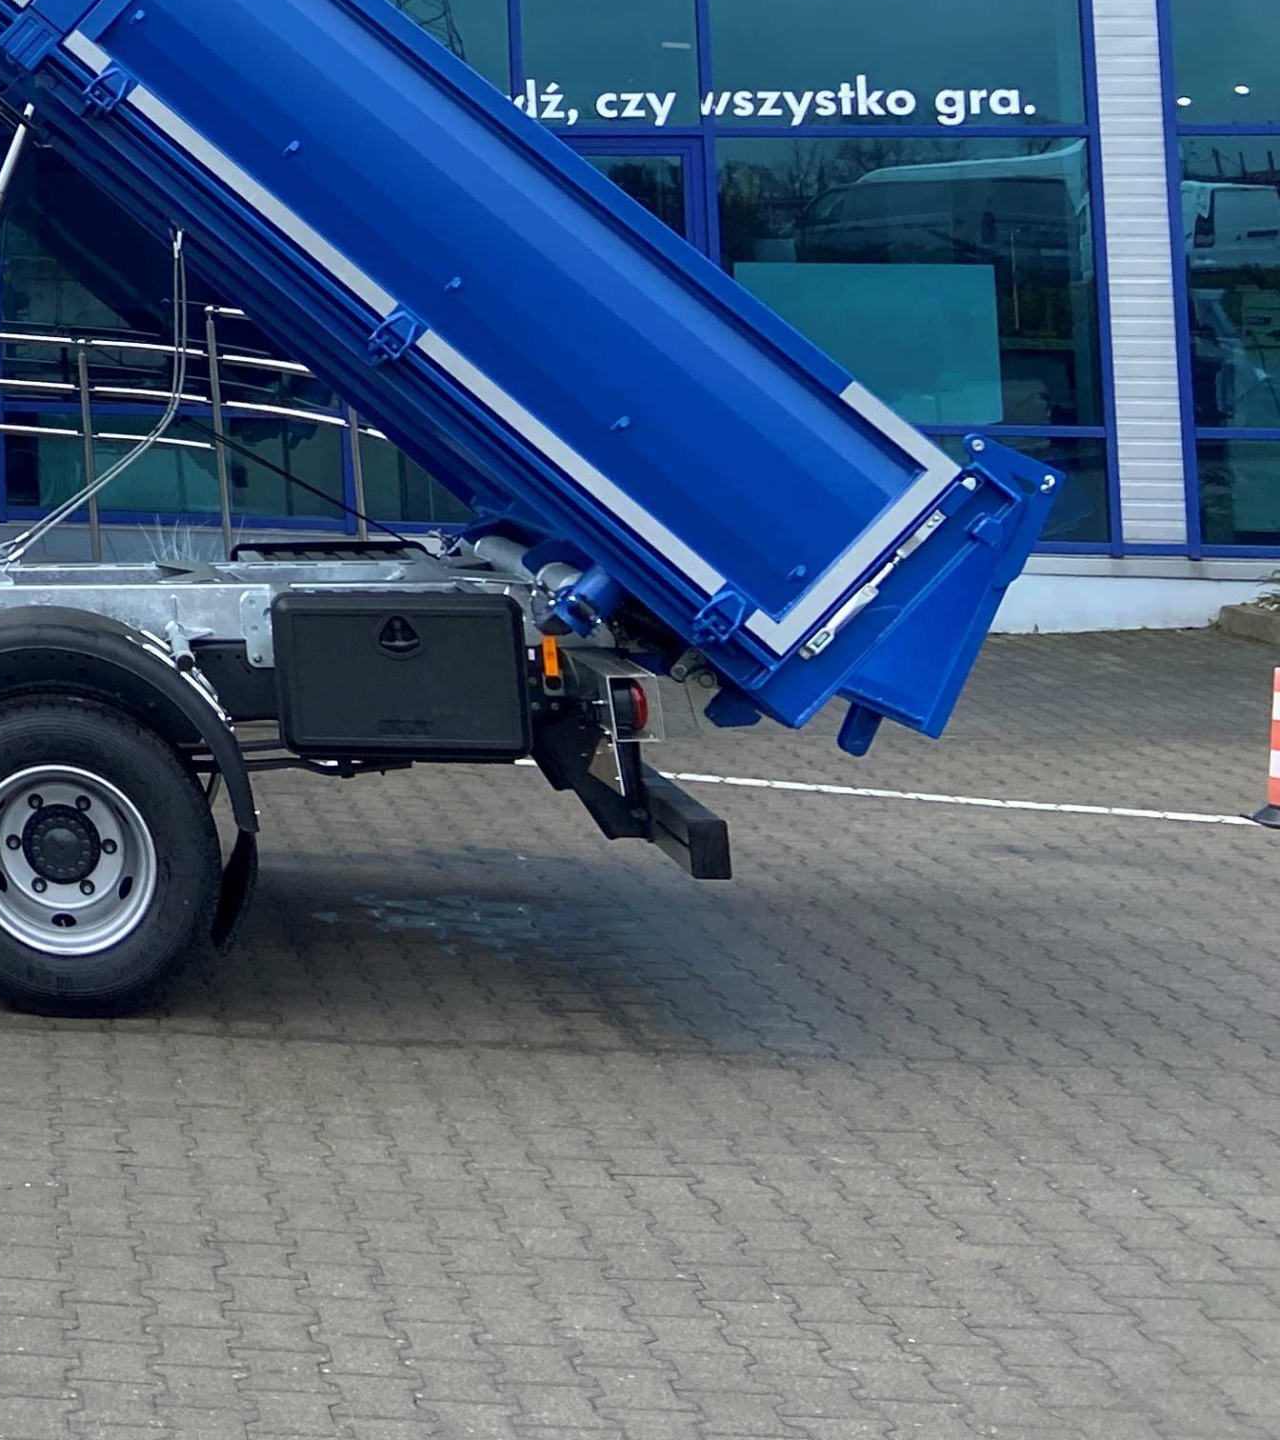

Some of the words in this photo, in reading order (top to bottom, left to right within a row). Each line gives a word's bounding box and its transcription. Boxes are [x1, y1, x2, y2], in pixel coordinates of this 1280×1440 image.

[595, 91, 677, 127] czy
[700, 74, 917, 127] wszystko
[934, 88, 1037, 126] gra.
